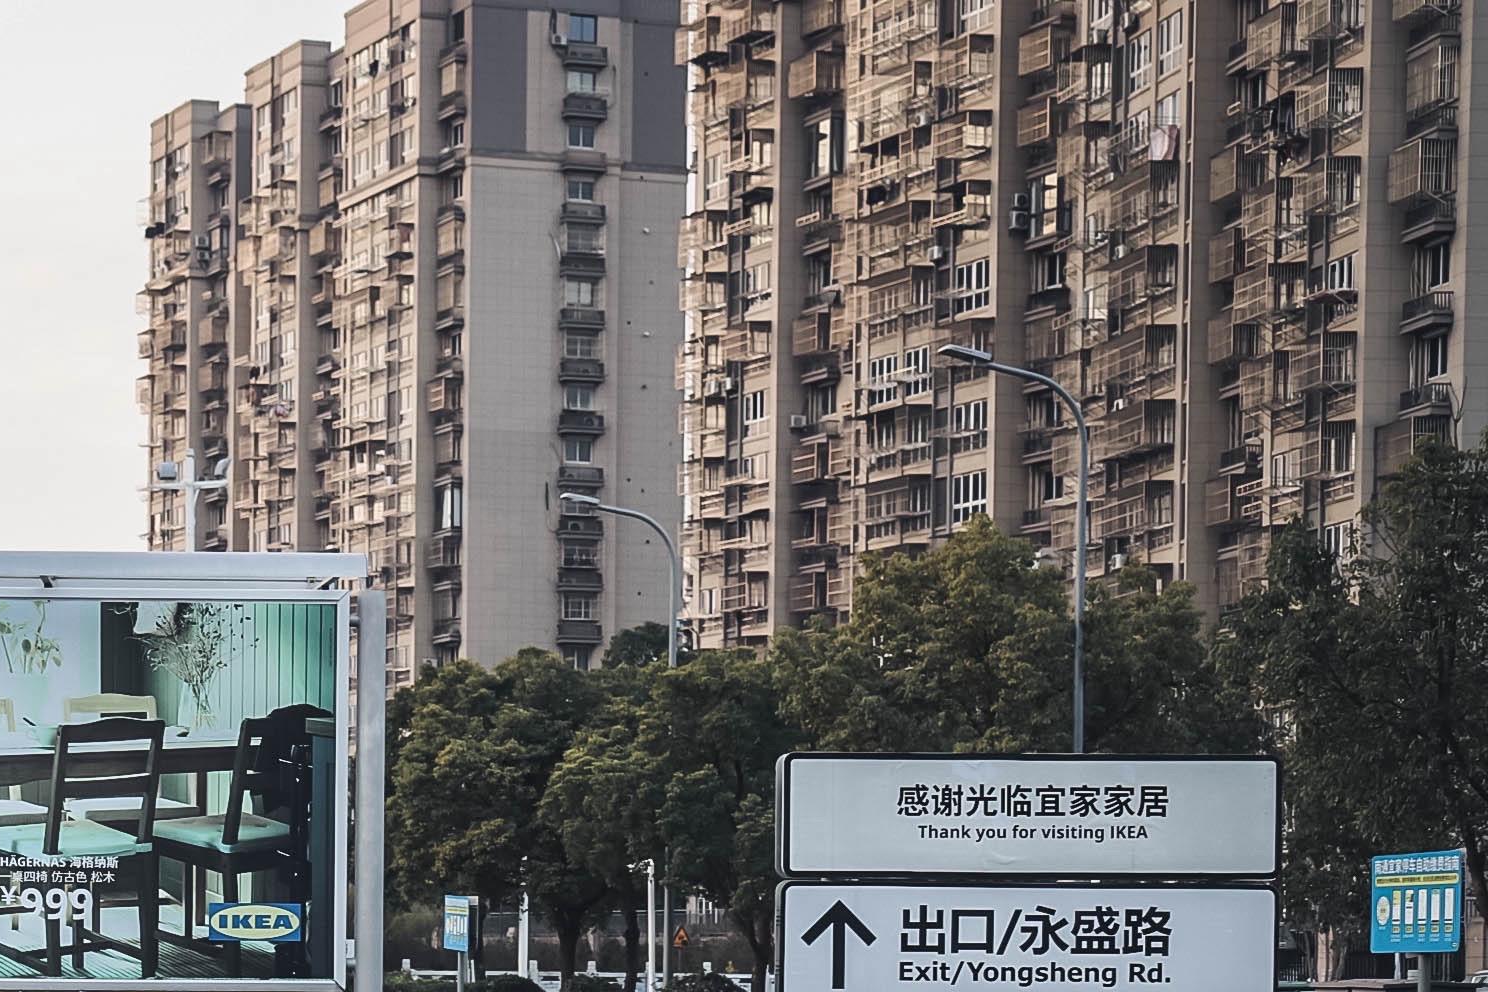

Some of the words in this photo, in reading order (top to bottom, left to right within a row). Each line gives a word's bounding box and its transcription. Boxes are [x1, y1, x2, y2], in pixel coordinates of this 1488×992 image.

[896, 784, 1169, 818] 感谢光临宜家家居
[918, 825, 971, 839] Thank
[976, 827, 1007, 842] you
[1012, 825, 1037, 839] for
[1041, 825, 1105, 843] visiting
[1110, 825, 1148, 839] IKEA
[69, 856, 119, 869] 海格纳斯
[0, 871, 48, 883] 一桌四椅
[51, 871, 88, 883] 仿古色
[90, 871, 116, 883] 松木
[0, 885, 93, 921] ¥999
[218, 914, 294, 929] IKEA
[900, 905, 1173, 957] 出口/永盛路
[898, 961, 1117, 987] Exit/Yongsheng
[1129, 963, 1171, 984] Rd.
